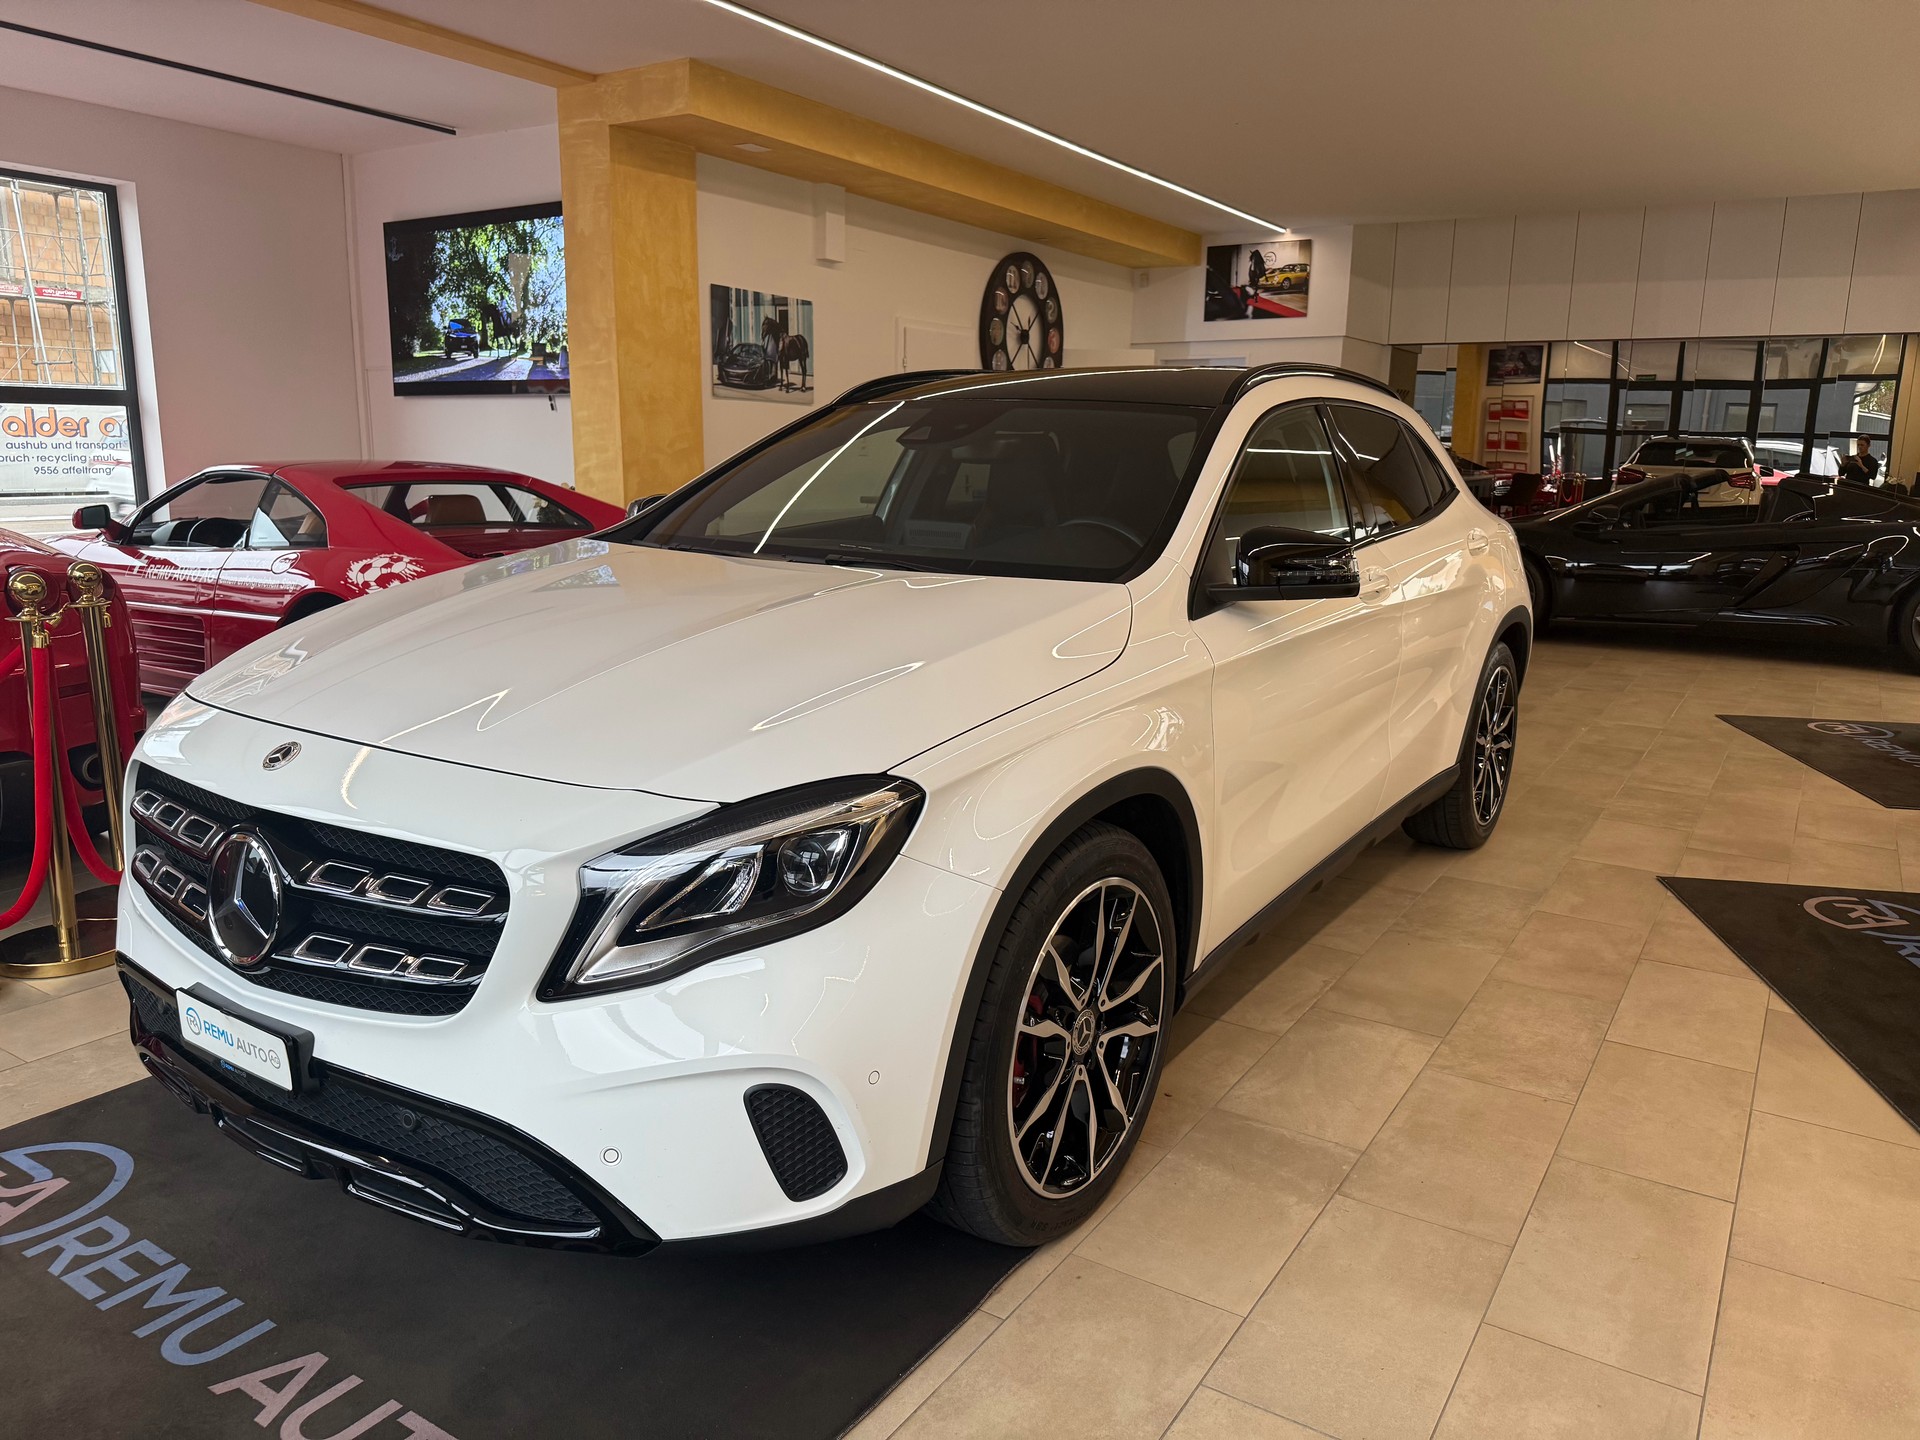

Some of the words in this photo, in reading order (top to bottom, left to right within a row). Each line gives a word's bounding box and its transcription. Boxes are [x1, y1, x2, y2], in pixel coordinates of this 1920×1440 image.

[2, 406, 89, 438] alder
[6, 441, 47, 450] aushub
[51, 441, 72, 450] und
[36, 453, 87, 464] recycling
[34, 466, 59, 475] 9556
[204, 1020, 234, 1047] REMU
[236, 1037, 268, 1063] AUTO
[21, 1215, 278, 1366] REMU
